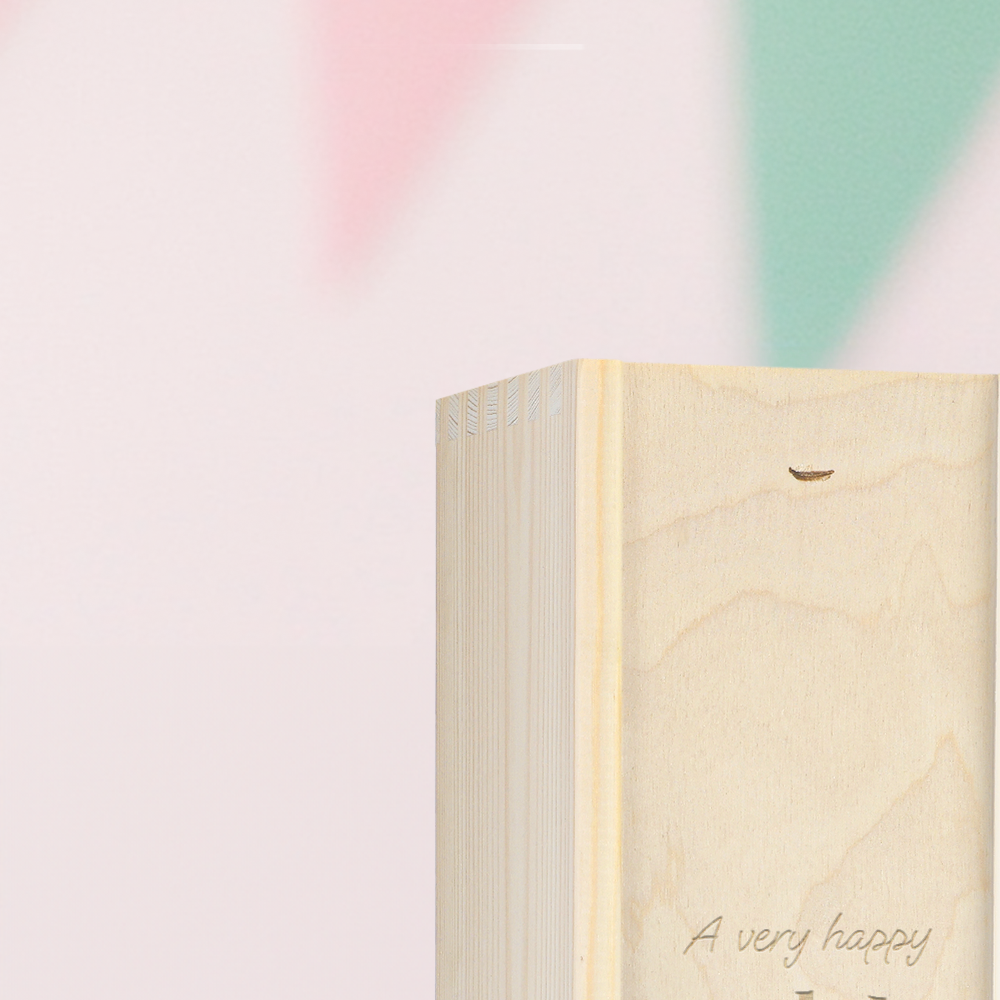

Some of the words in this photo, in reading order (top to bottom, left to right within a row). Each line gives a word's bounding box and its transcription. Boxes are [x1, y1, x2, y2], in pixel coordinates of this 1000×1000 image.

[683, 915, 723, 955] A
[738, 928, 811, 969] very
[822, 912, 933, 967] happy
